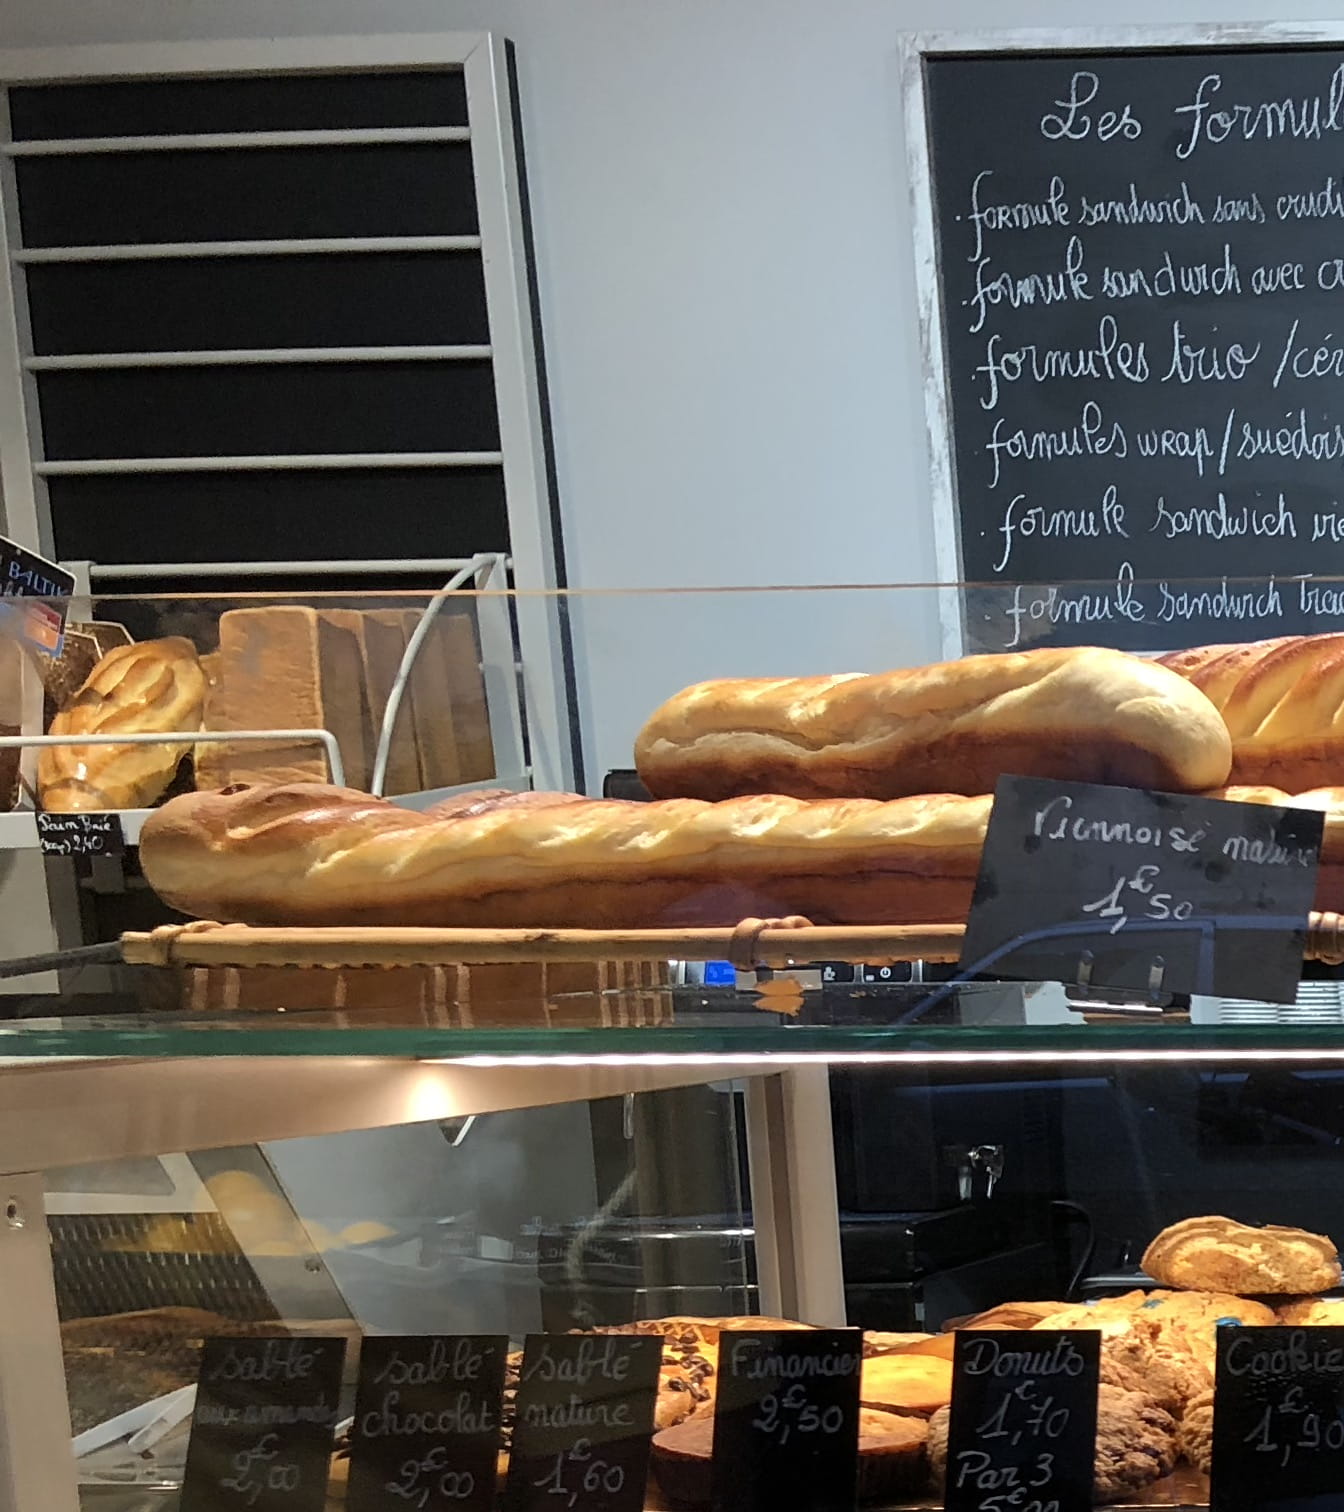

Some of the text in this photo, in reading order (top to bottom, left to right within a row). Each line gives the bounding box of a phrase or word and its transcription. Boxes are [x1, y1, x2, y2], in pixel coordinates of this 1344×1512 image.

[1041, 71, 1141, 141] Les
[967, 171, 1071, 261] formule
[1079, 183, 1205, 226] sandwich
[1213, 196, 1265, 223] sans
[968, 235, 1094, 334] formule
[1102, 244, 1241, 300] sandwich
[1252, 266, 1304, 295] avec
[976, 315, 1150, 410] formules
[986, 401, 1126, 488] formules
[999, 486, 1125, 573] formule
[1151, 499, 1296, 539] sandwich
[1007, 562, 1282, 640] formule sandwich
[523, 1339, 641, 1385] sablé
[964, 1336, 1084, 1376] Donuts
[361, 1391, 495, 1437] chocolat
[524, 1395, 634, 1428] nature
[957, 1451, 1053, 1489] Par 3
